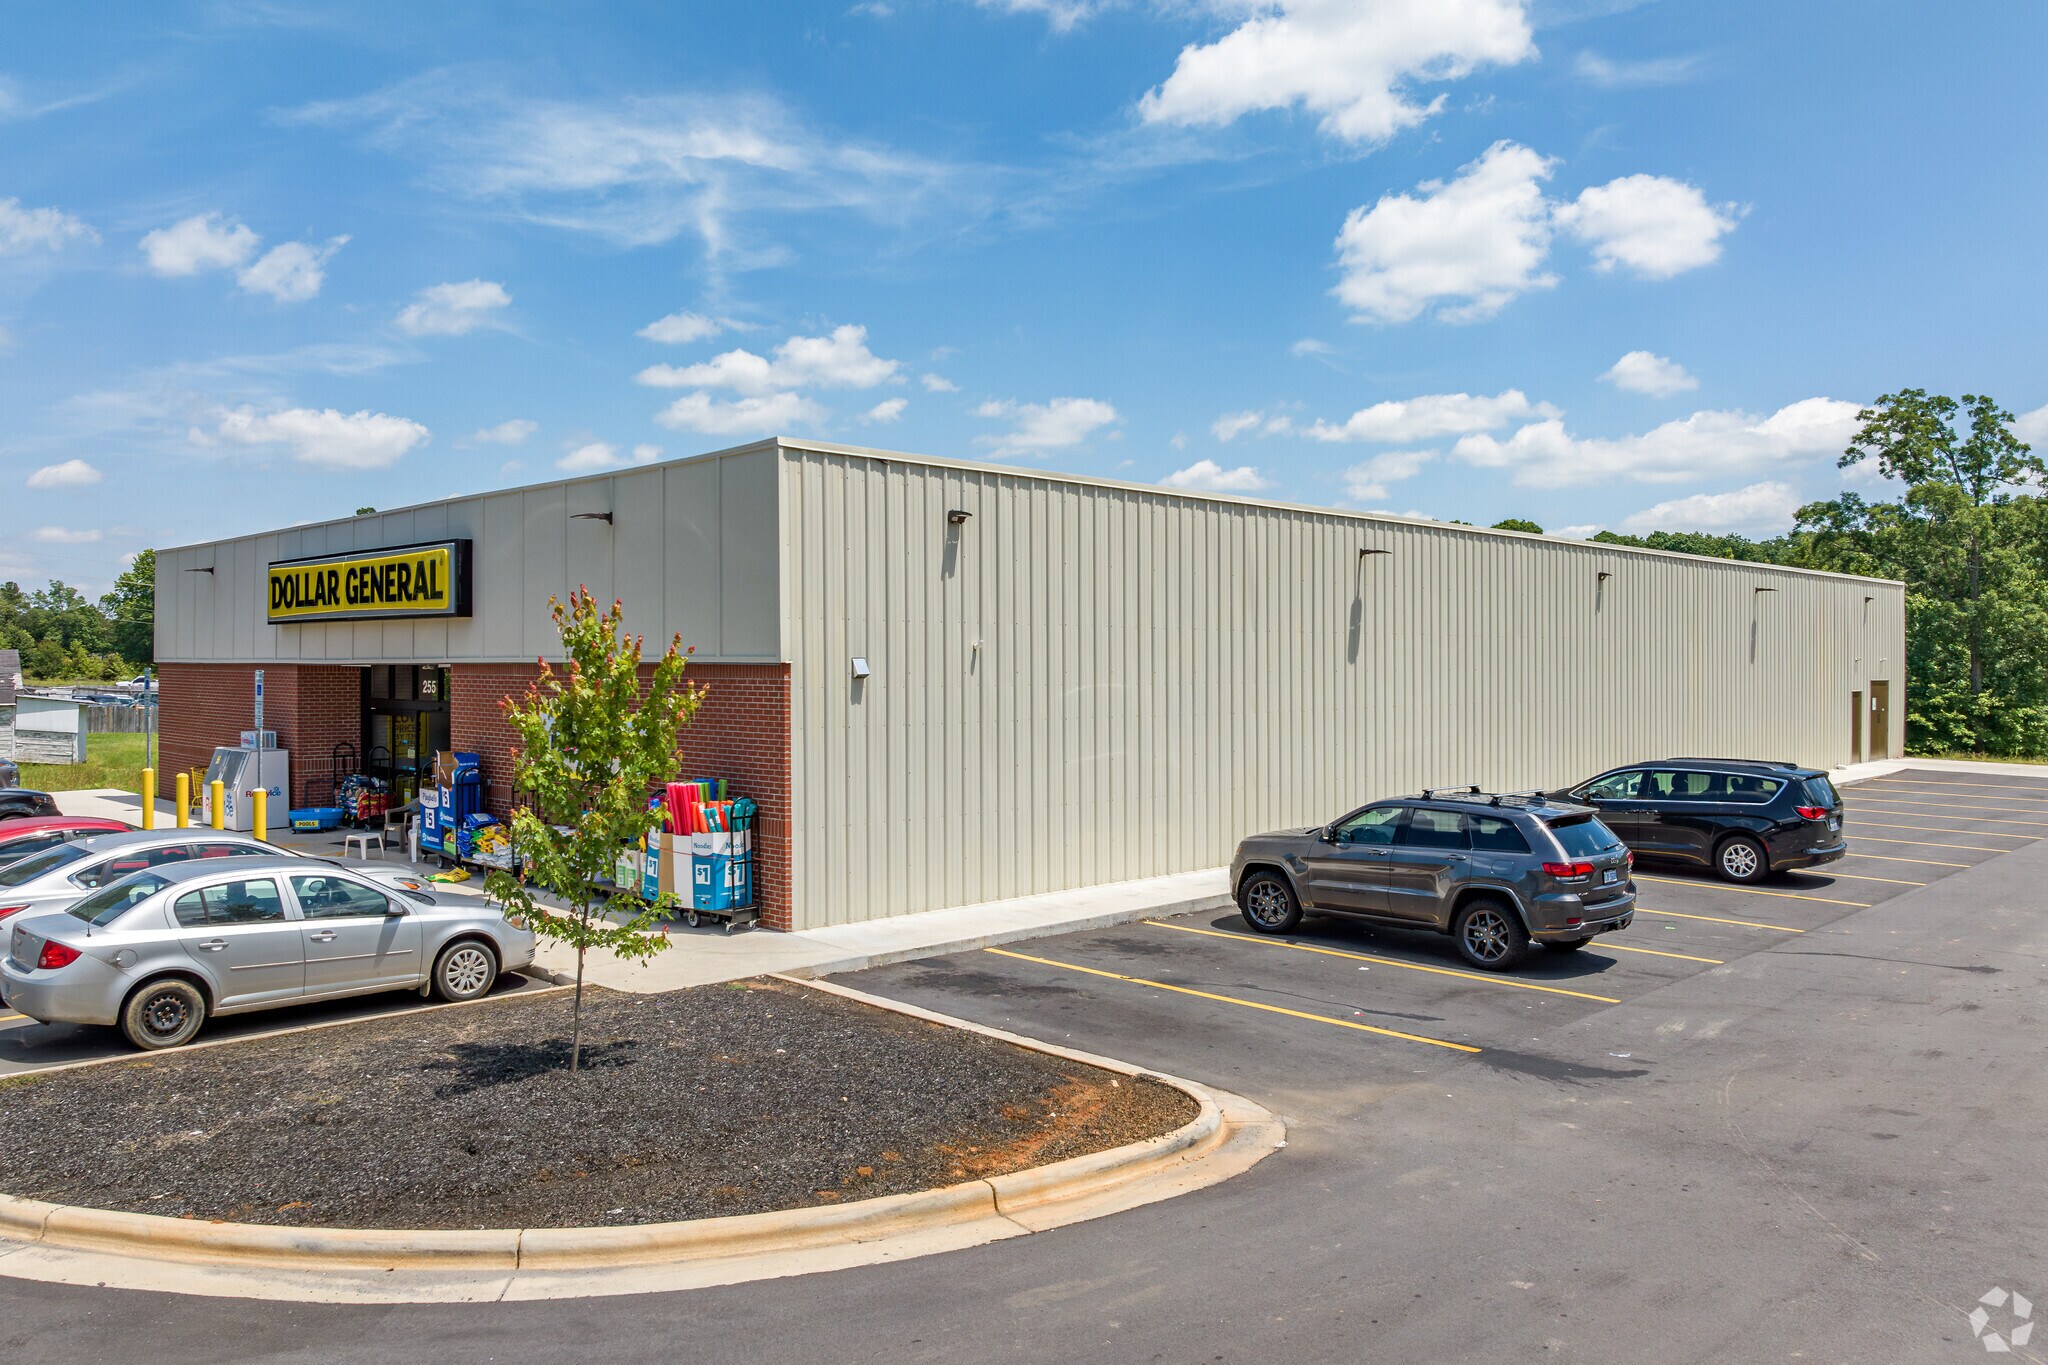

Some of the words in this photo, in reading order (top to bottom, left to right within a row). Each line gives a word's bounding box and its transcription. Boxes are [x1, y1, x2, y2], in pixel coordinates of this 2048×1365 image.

[271, 570, 340, 609] DOLLAR
[345, 559, 443, 605] GENERAL
[422, 680, 437, 693] 255
[648, 859, 657, 875] $1
[697, 867, 709, 882] $1
